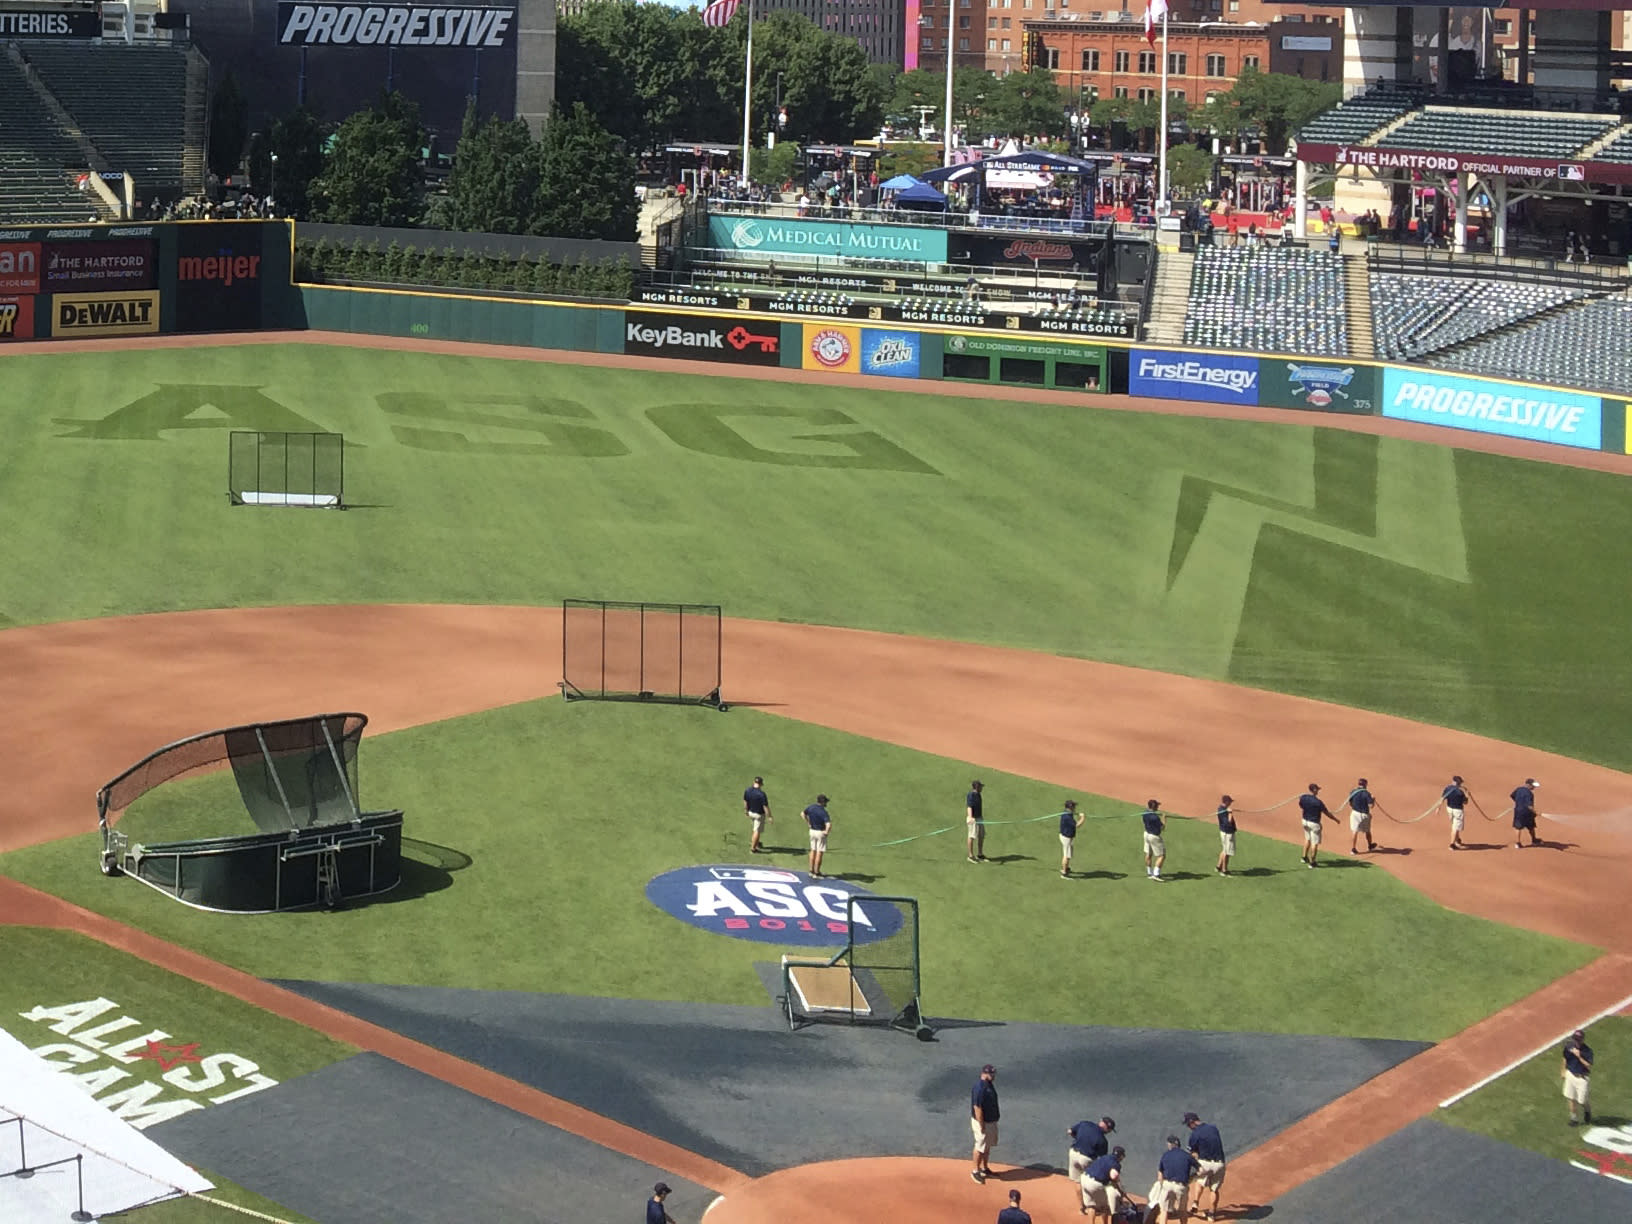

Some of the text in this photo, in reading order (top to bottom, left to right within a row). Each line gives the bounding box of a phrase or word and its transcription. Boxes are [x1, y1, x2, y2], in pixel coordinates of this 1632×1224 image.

[281, 5, 515, 47] PROGRESSIVE
[1349, 150, 1557, 177] THE HARTFORD OFFICIAL PARTNER OF
[766, 227, 922, 251] MEDICAL MUTUAL
[60, 256, 144, 268] THE HARTFORD
[178, 249, 260, 286] meijer
[642, 292, 718, 305] MGM RESORTS
[769, 302, 848, 315] MGM RESORTS
[902, 311, 984, 325] MGM RESORTS
[1041, 321, 1127, 335] MGM RESORTS
[627, 323, 724, 348] KeyBank
[969, 341, 985, 350] OLD
[986, 342, 1027, 353] DOMINION
[872, 347, 913, 365] CLEAN
[1139, 358, 1257, 388] FirstEnergy
[1353, 399, 1371, 409] 375
[1394, 382, 1585, 433] PROGRESSIVE
[686, 881, 872, 927] ASG
[18, 997, 174, 1064] ALL
